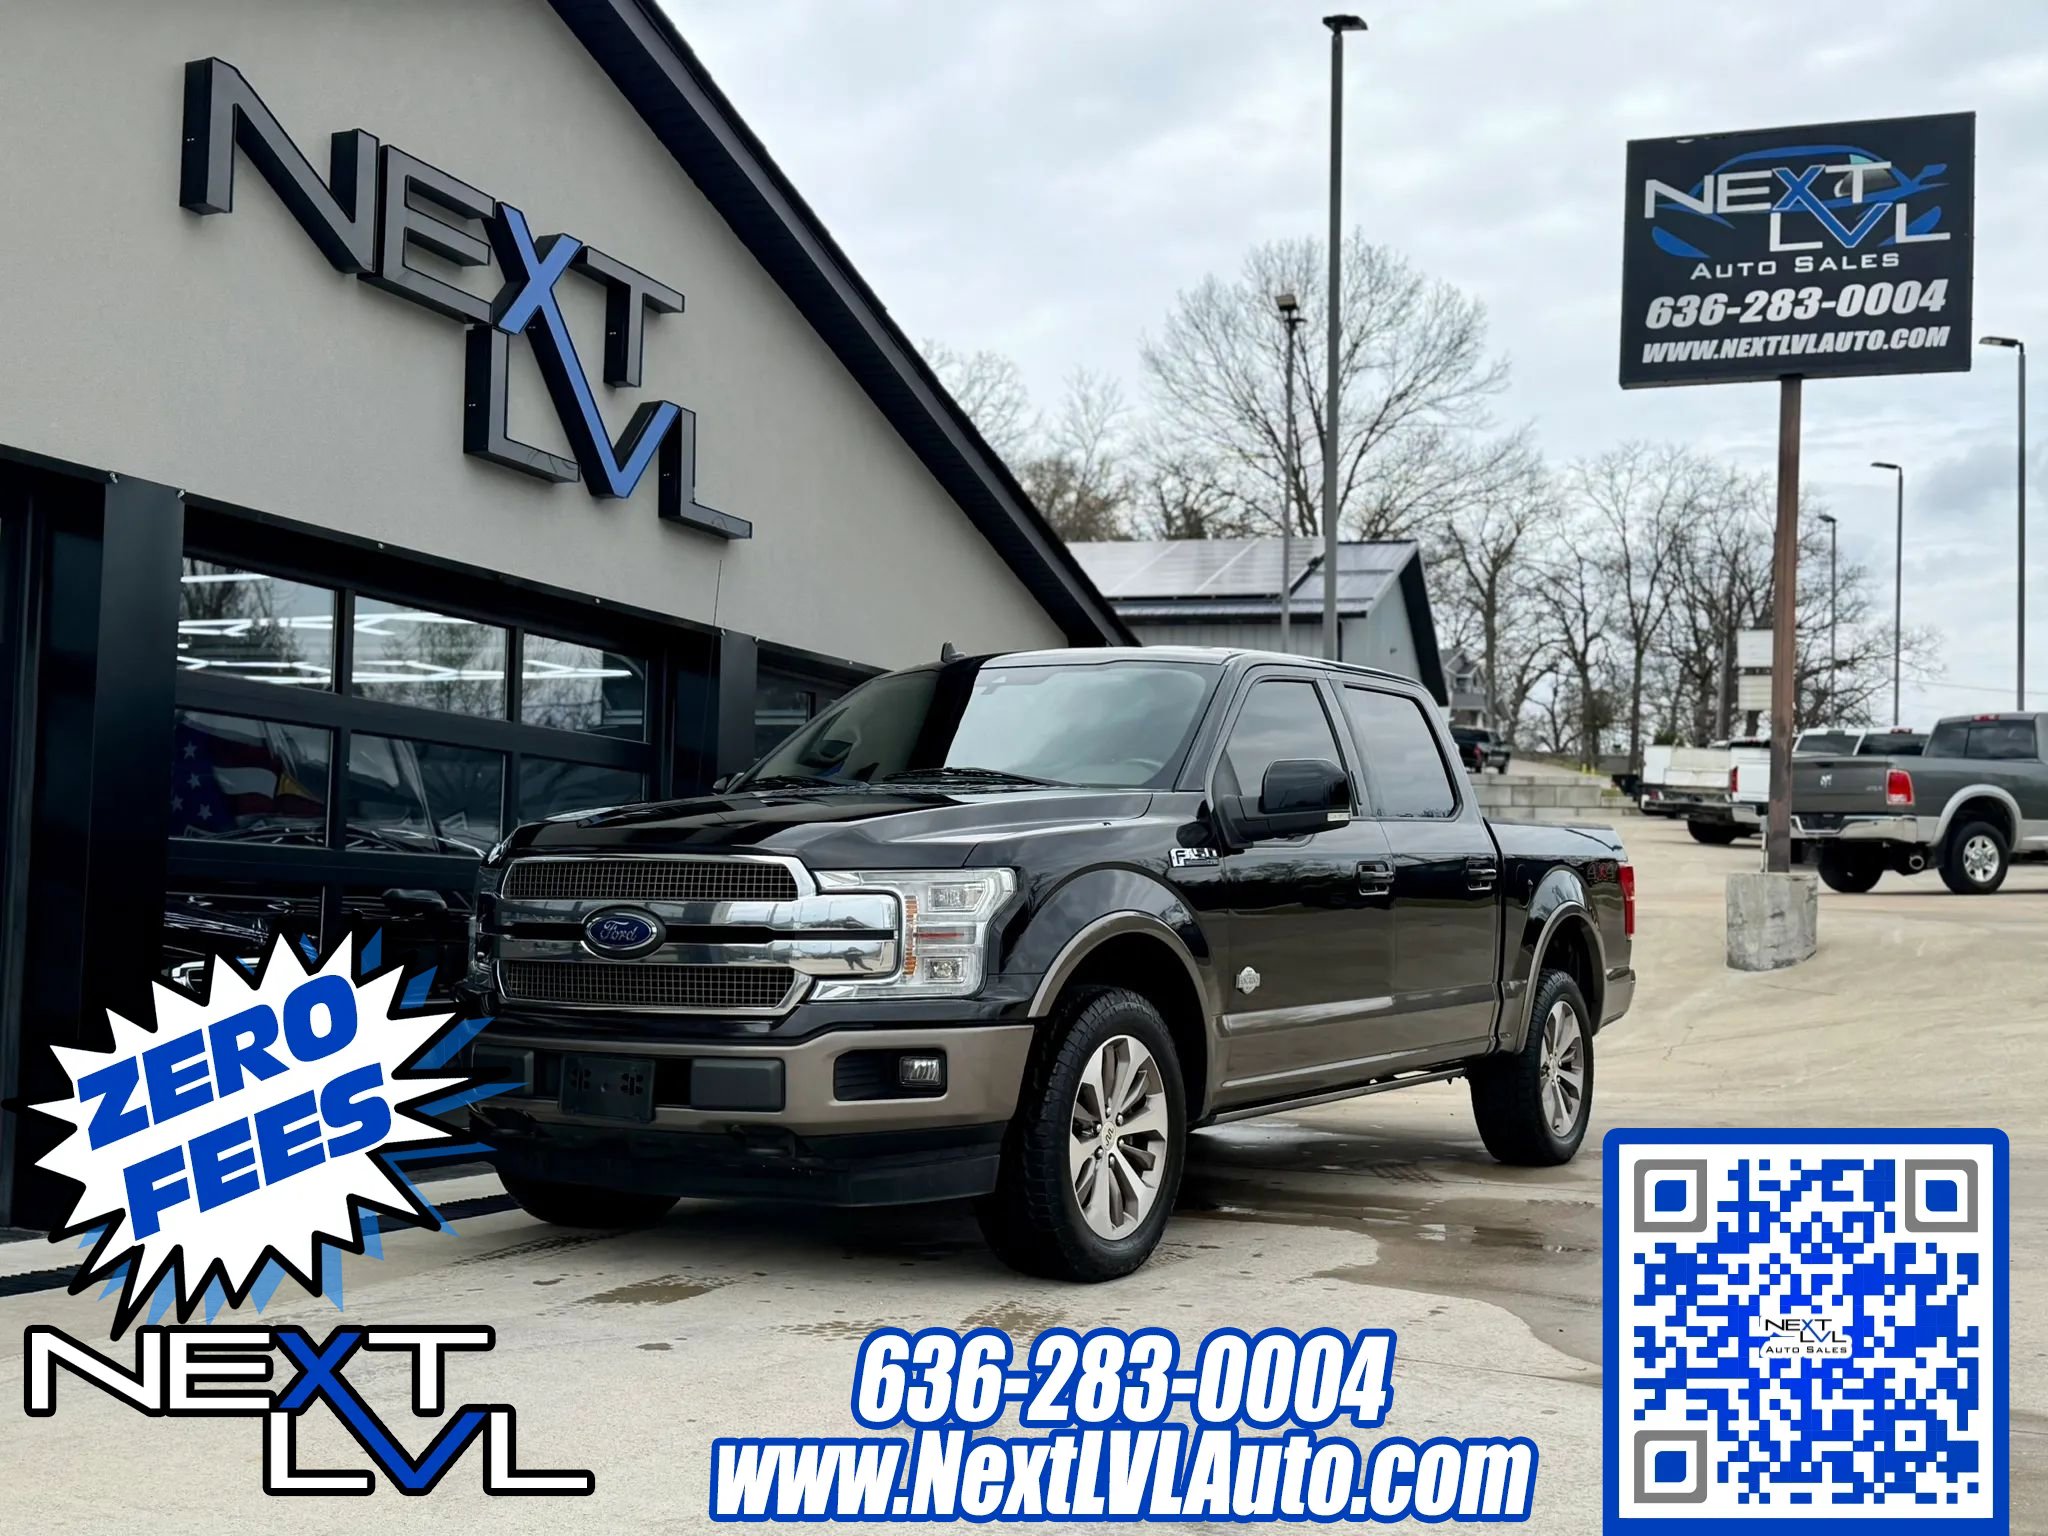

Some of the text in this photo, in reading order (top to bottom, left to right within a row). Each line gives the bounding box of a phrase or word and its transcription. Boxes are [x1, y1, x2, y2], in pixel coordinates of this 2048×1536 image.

[1644, 160, 1892, 219] NEXT
[180, 57, 684, 388] NEXT
[1768, 202, 1951, 252] LVL
[1645, 278, 1949, 330] 636-283-0004
[1642, 326, 1951, 364] WWW.NEXTLVLAUTO.COM
[462, 325, 752, 540] LVL
[600, 920, 639, 941] Ford
